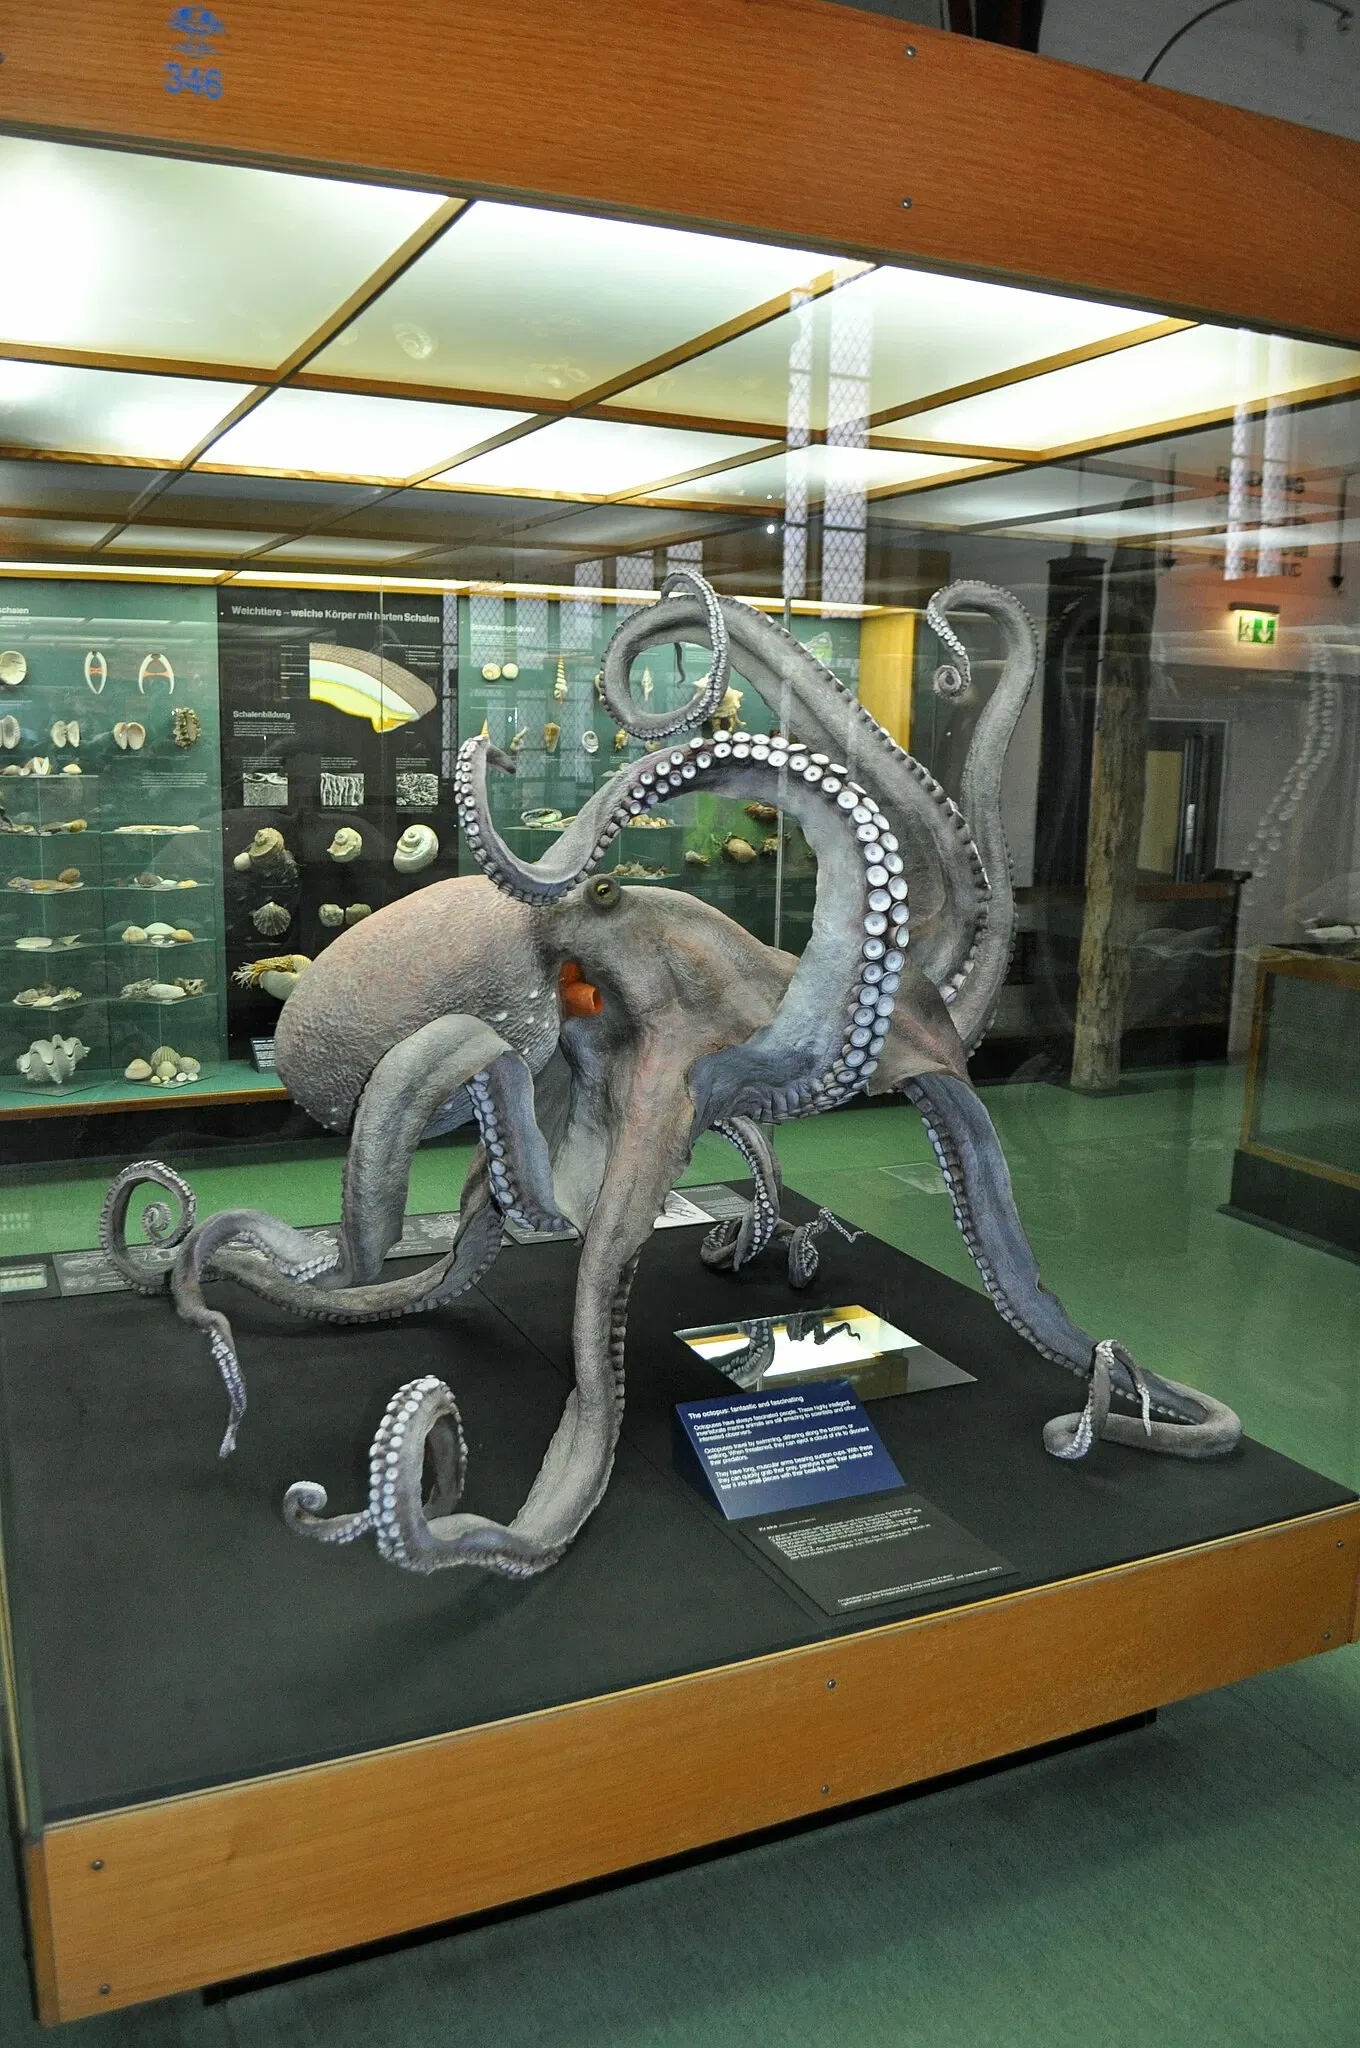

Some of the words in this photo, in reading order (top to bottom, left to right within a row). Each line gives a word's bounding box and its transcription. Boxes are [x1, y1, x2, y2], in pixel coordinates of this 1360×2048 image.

[164, 62, 223, 100] 346
[231, 605, 282, 616] Weichtiere
[291, 608, 323, 618] weiche
[324, 609, 356, 621] Körper
[358, 611, 373, 620] mit
[374, 611, 403, 622] harten
[403, 612, 440, 624] Schalen
[232, 710, 291, 720] Schalenbildung
[702, 1407, 729, 1417] octopus:
[730, 1403, 756, 1412] fantastic
[758, 1400, 769, 1408] and
[771, 1396, 803, 1406] fascinating
